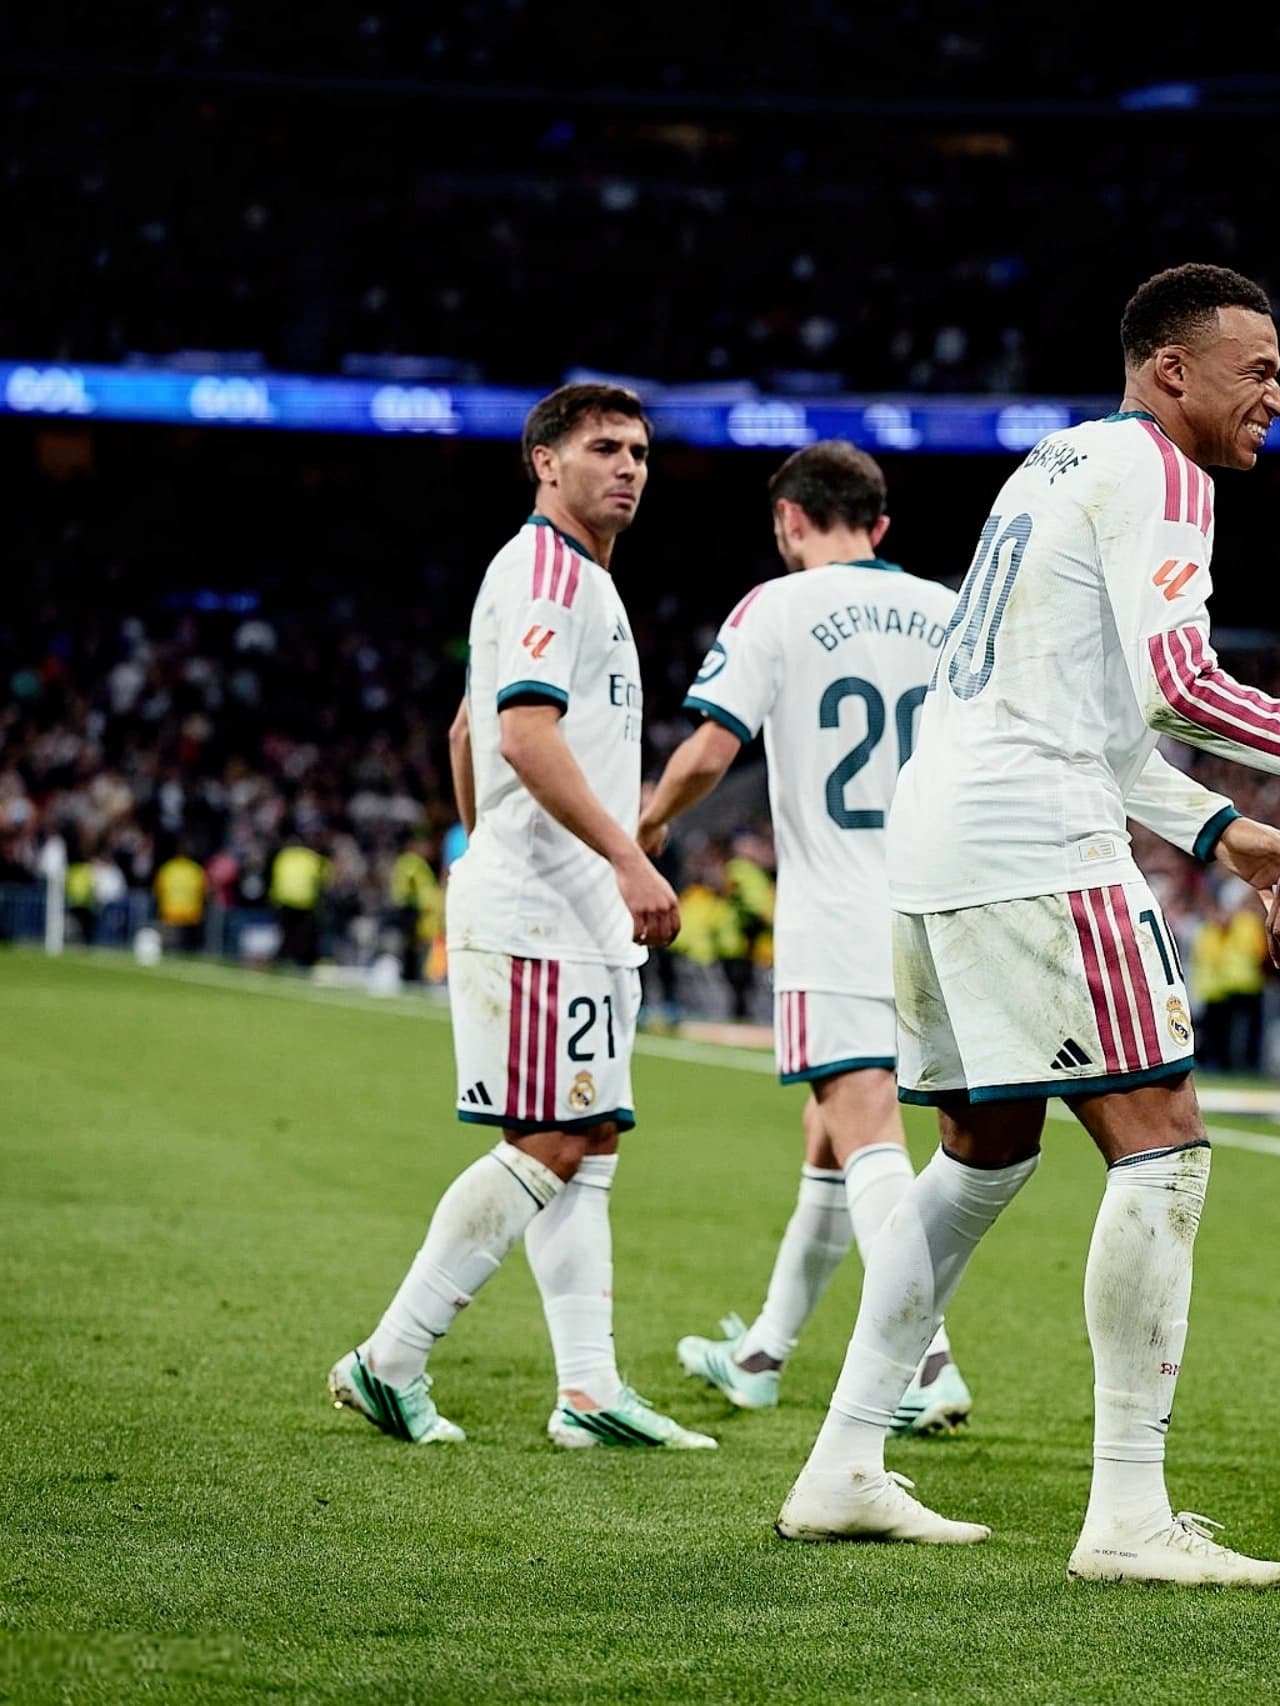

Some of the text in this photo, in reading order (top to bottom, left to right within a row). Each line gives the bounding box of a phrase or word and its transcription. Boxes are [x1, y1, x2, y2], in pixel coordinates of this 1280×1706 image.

[1023, 439, 1088, 486] BAPPÉ
[811, 604, 946, 652] BERNARD
[567, 995, 616, 1061] 21
